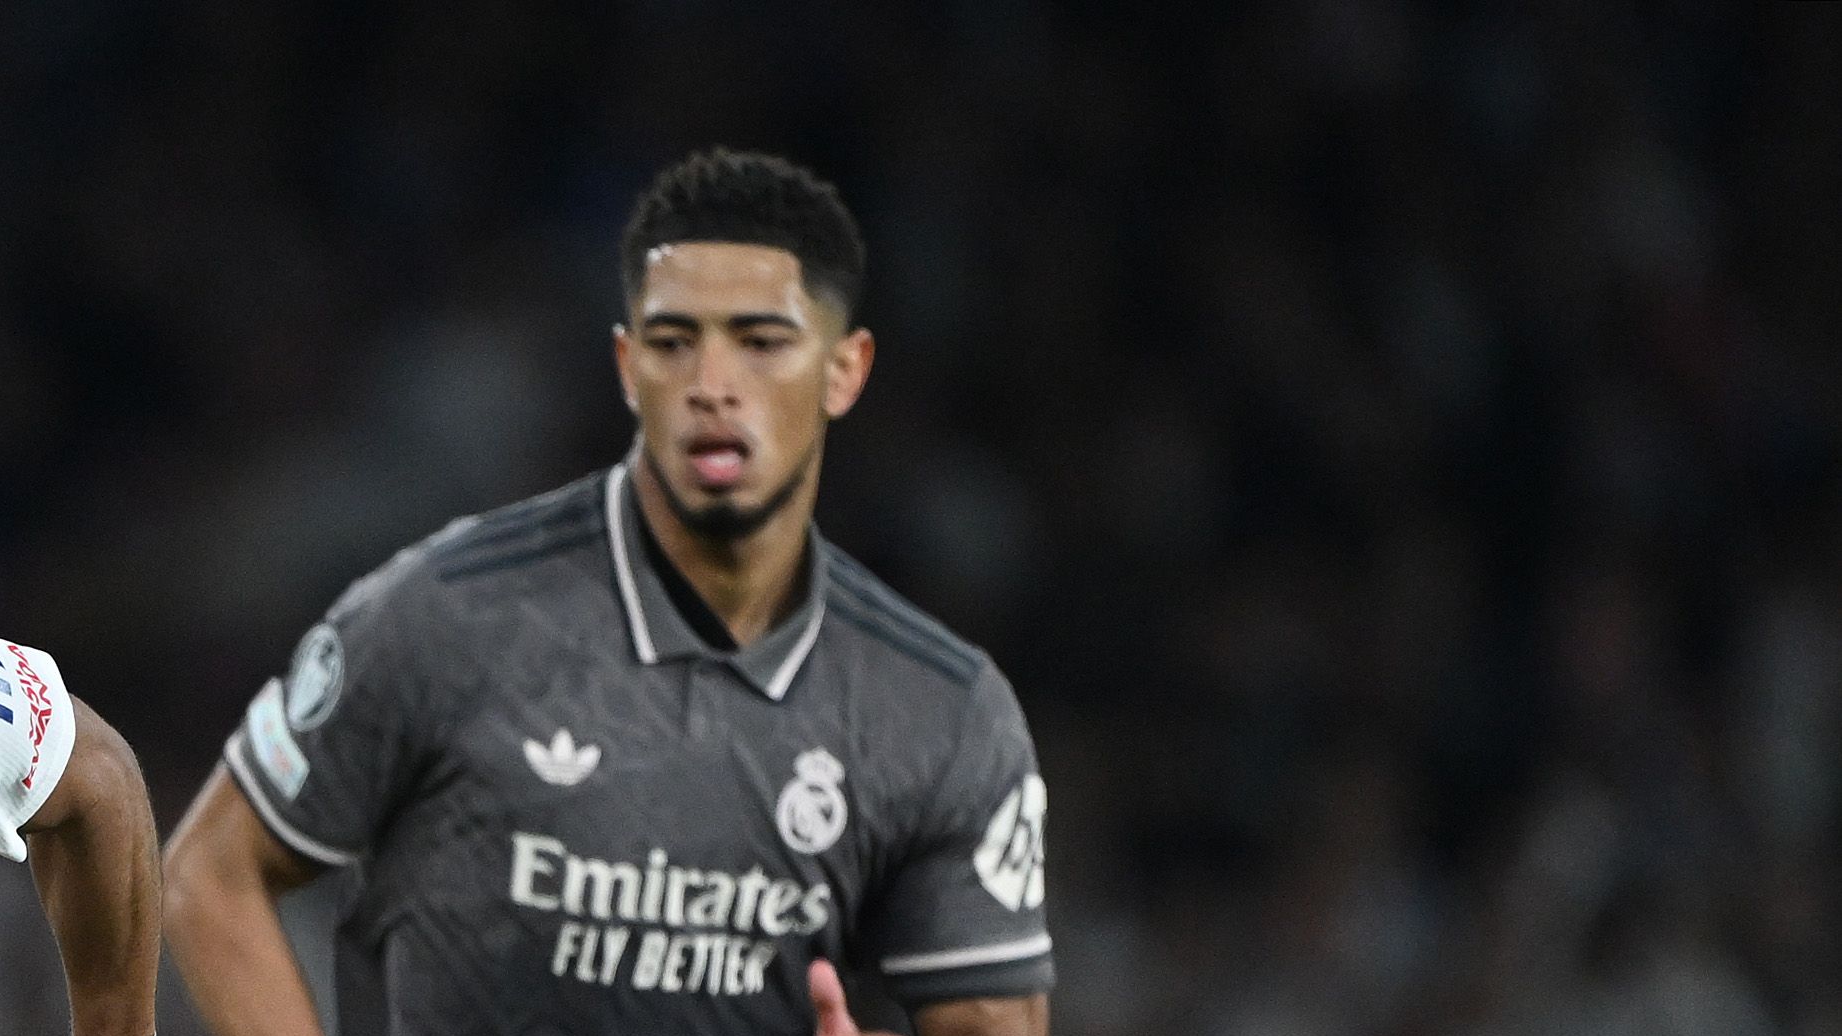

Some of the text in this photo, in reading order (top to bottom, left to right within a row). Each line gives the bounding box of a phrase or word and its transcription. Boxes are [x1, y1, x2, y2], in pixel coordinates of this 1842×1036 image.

[510, 830, 831, 936] Emirates
[551, 920, 777, 996] FLY BETTER
